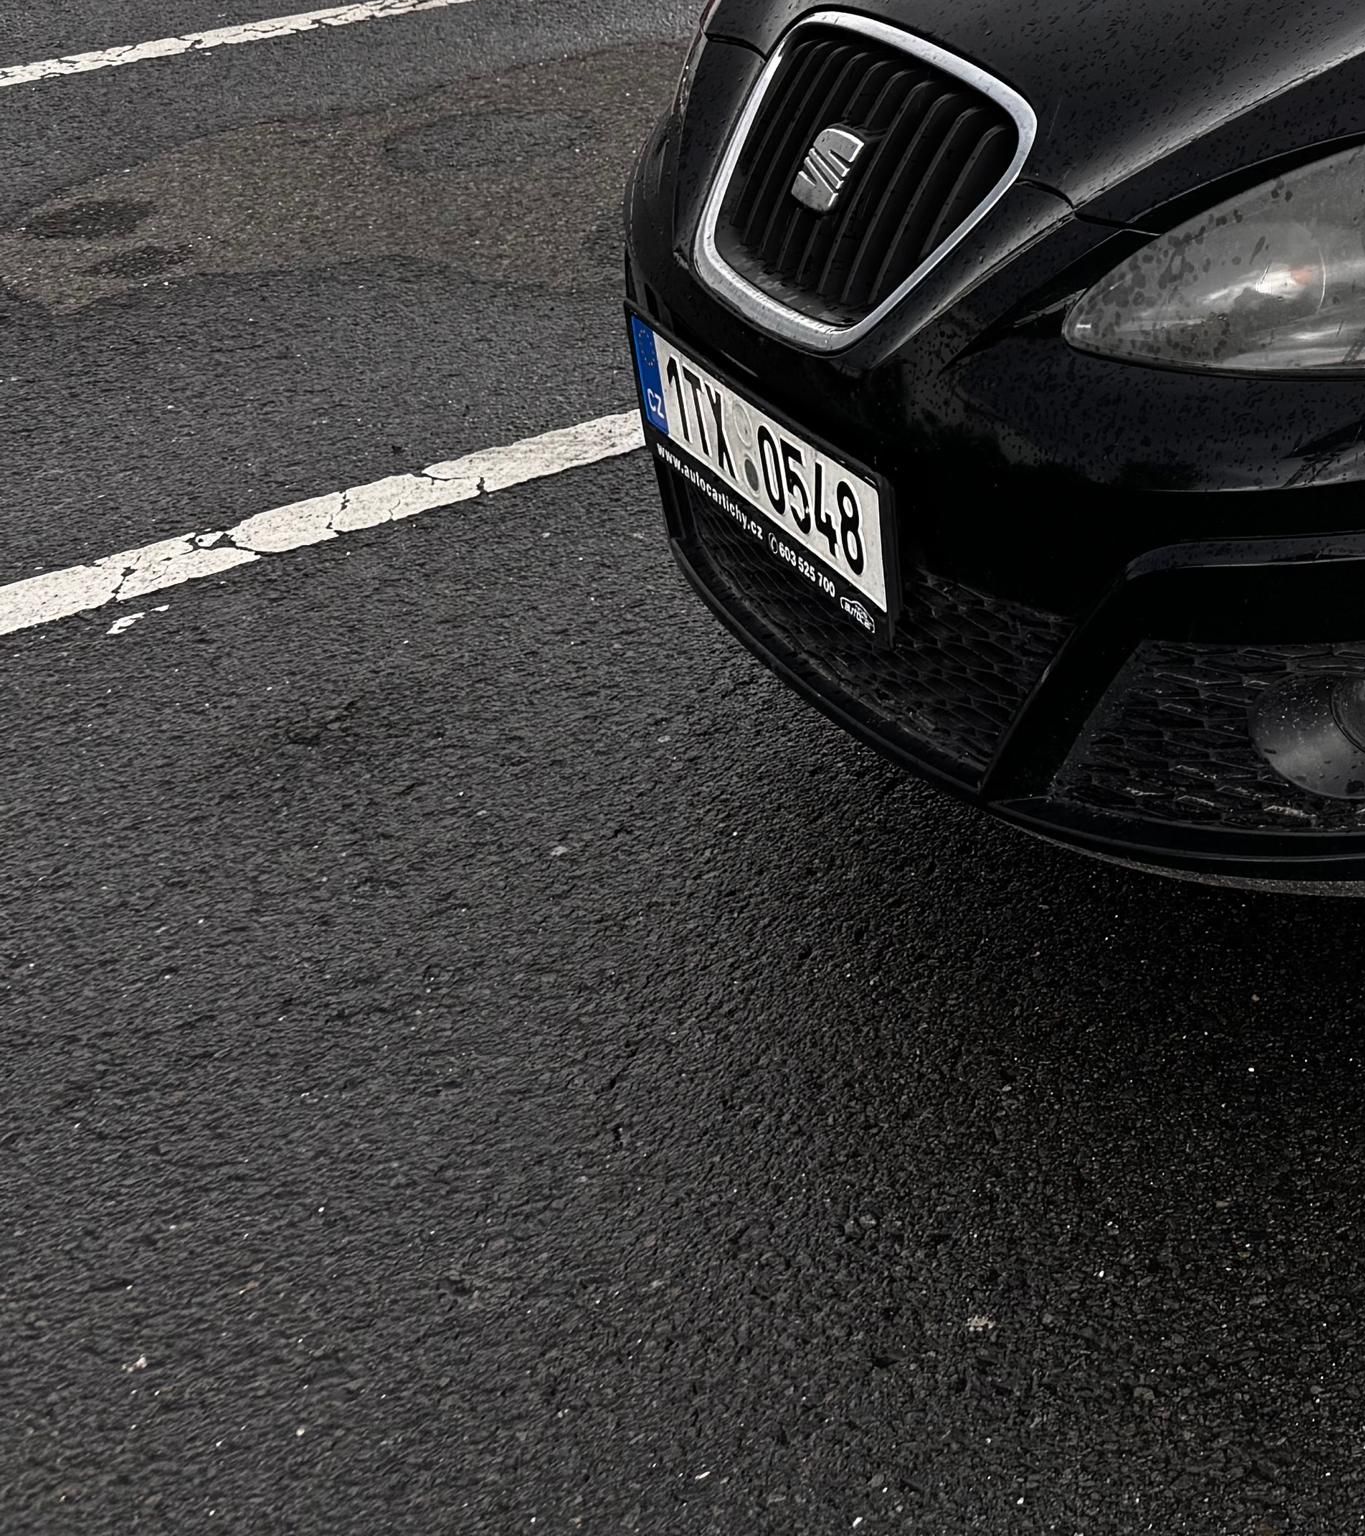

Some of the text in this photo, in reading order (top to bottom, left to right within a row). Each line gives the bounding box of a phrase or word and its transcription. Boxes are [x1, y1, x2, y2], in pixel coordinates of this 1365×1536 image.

[647, 387, 665, 419] CZ
[667, 355, 864, 576] 1TX 0548
[779, 541, 836, 598] 603 525 700
